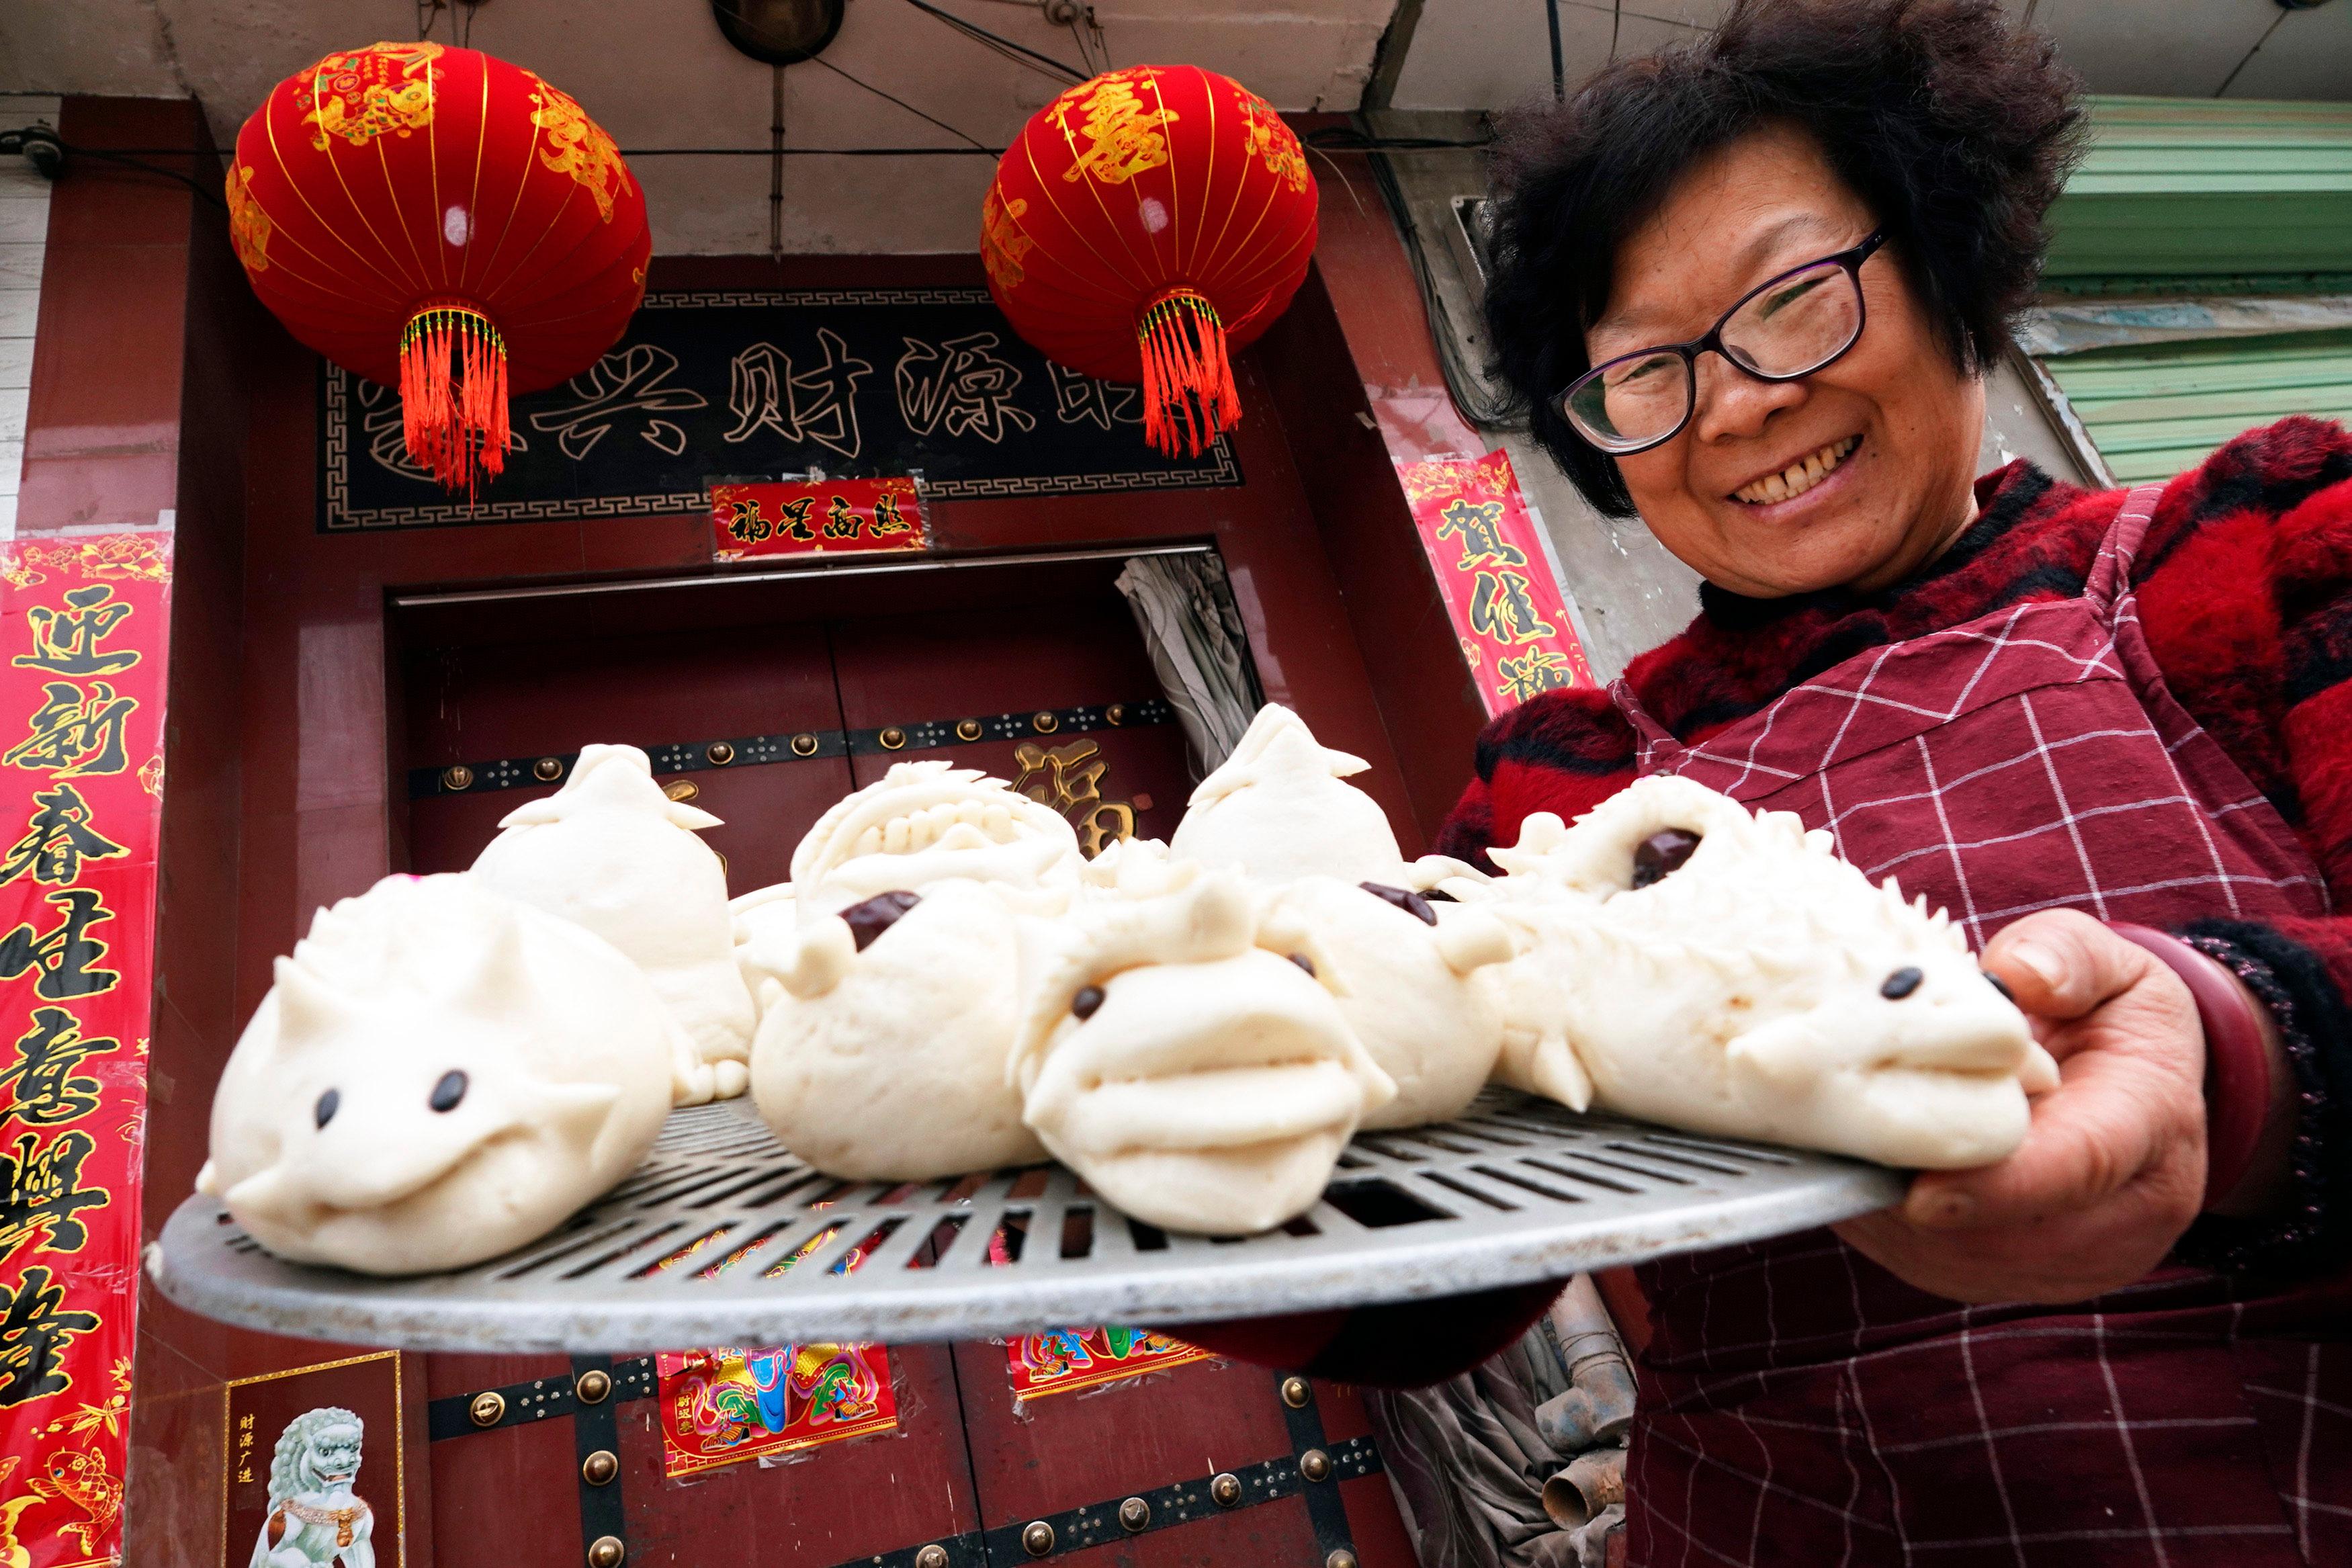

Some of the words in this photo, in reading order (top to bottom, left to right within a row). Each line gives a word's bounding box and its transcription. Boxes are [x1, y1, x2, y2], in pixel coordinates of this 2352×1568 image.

[728, 493, 910, 545] 福星高照
[238, 1413, 255, 1483] 财源广进
